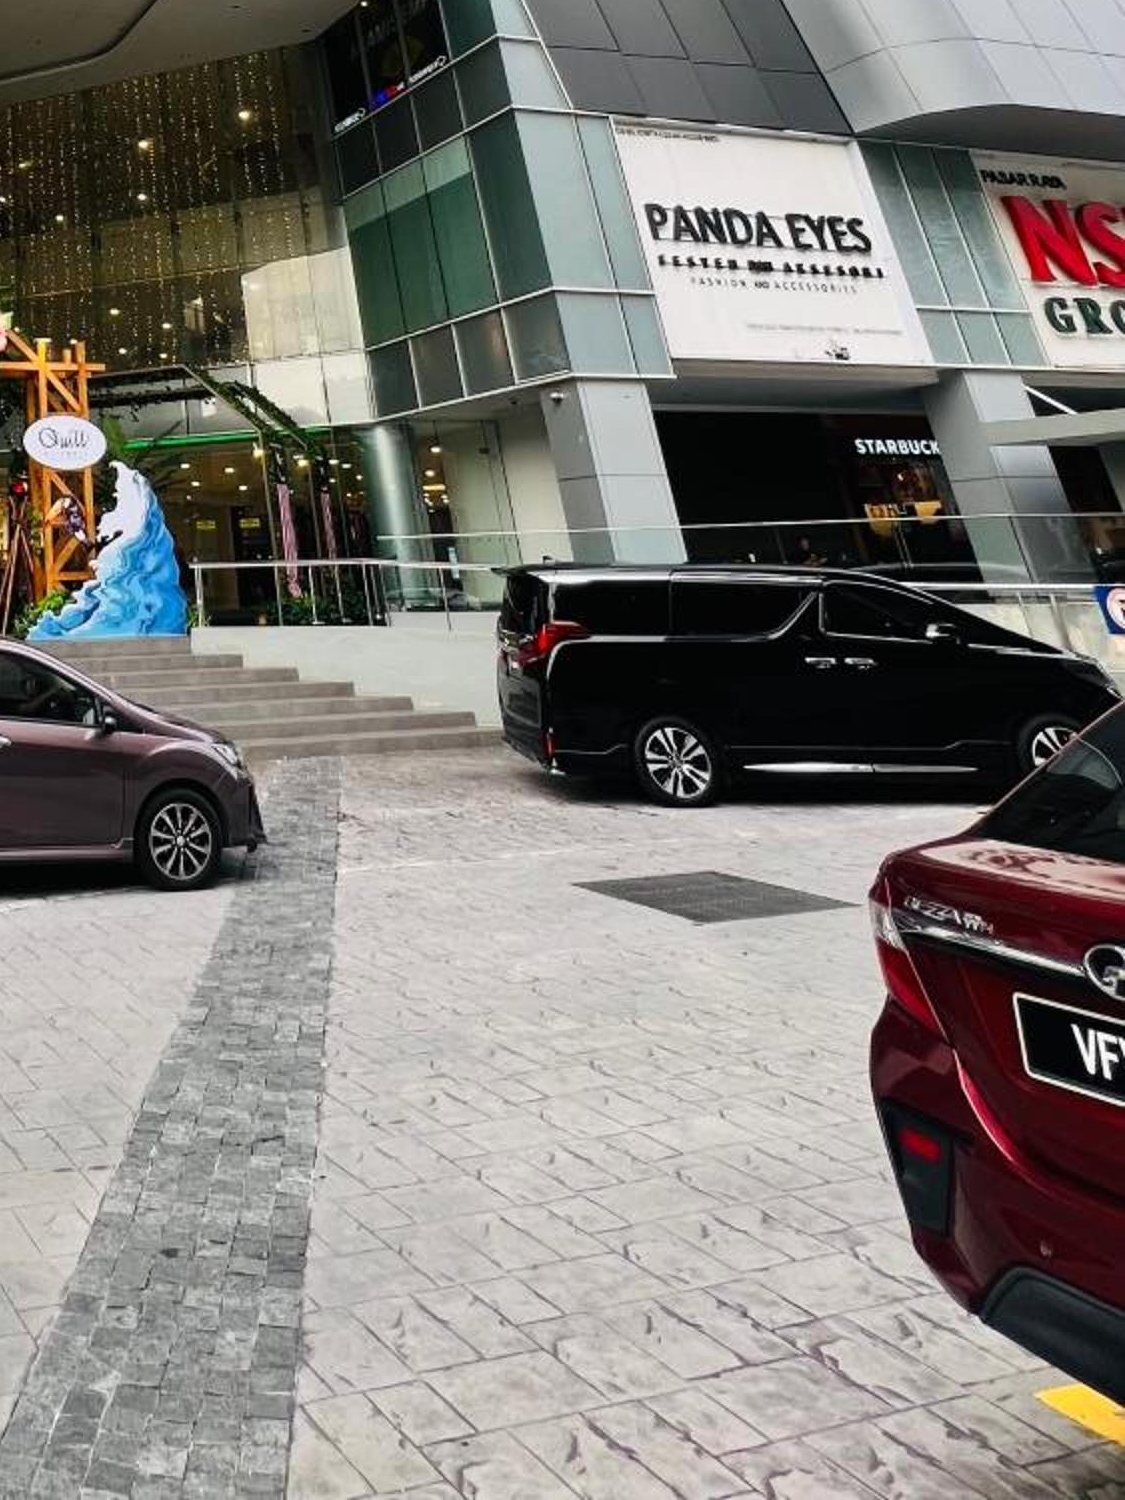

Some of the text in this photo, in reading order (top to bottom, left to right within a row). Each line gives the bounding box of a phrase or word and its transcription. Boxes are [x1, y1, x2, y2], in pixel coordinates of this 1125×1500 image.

[643, 203, 872, 252] PANDA EYES
[1000, 195, 1125, 289] NS
[37, 426, 88, 449] Quill
[1070, 1022, 1125, 1080] VF
